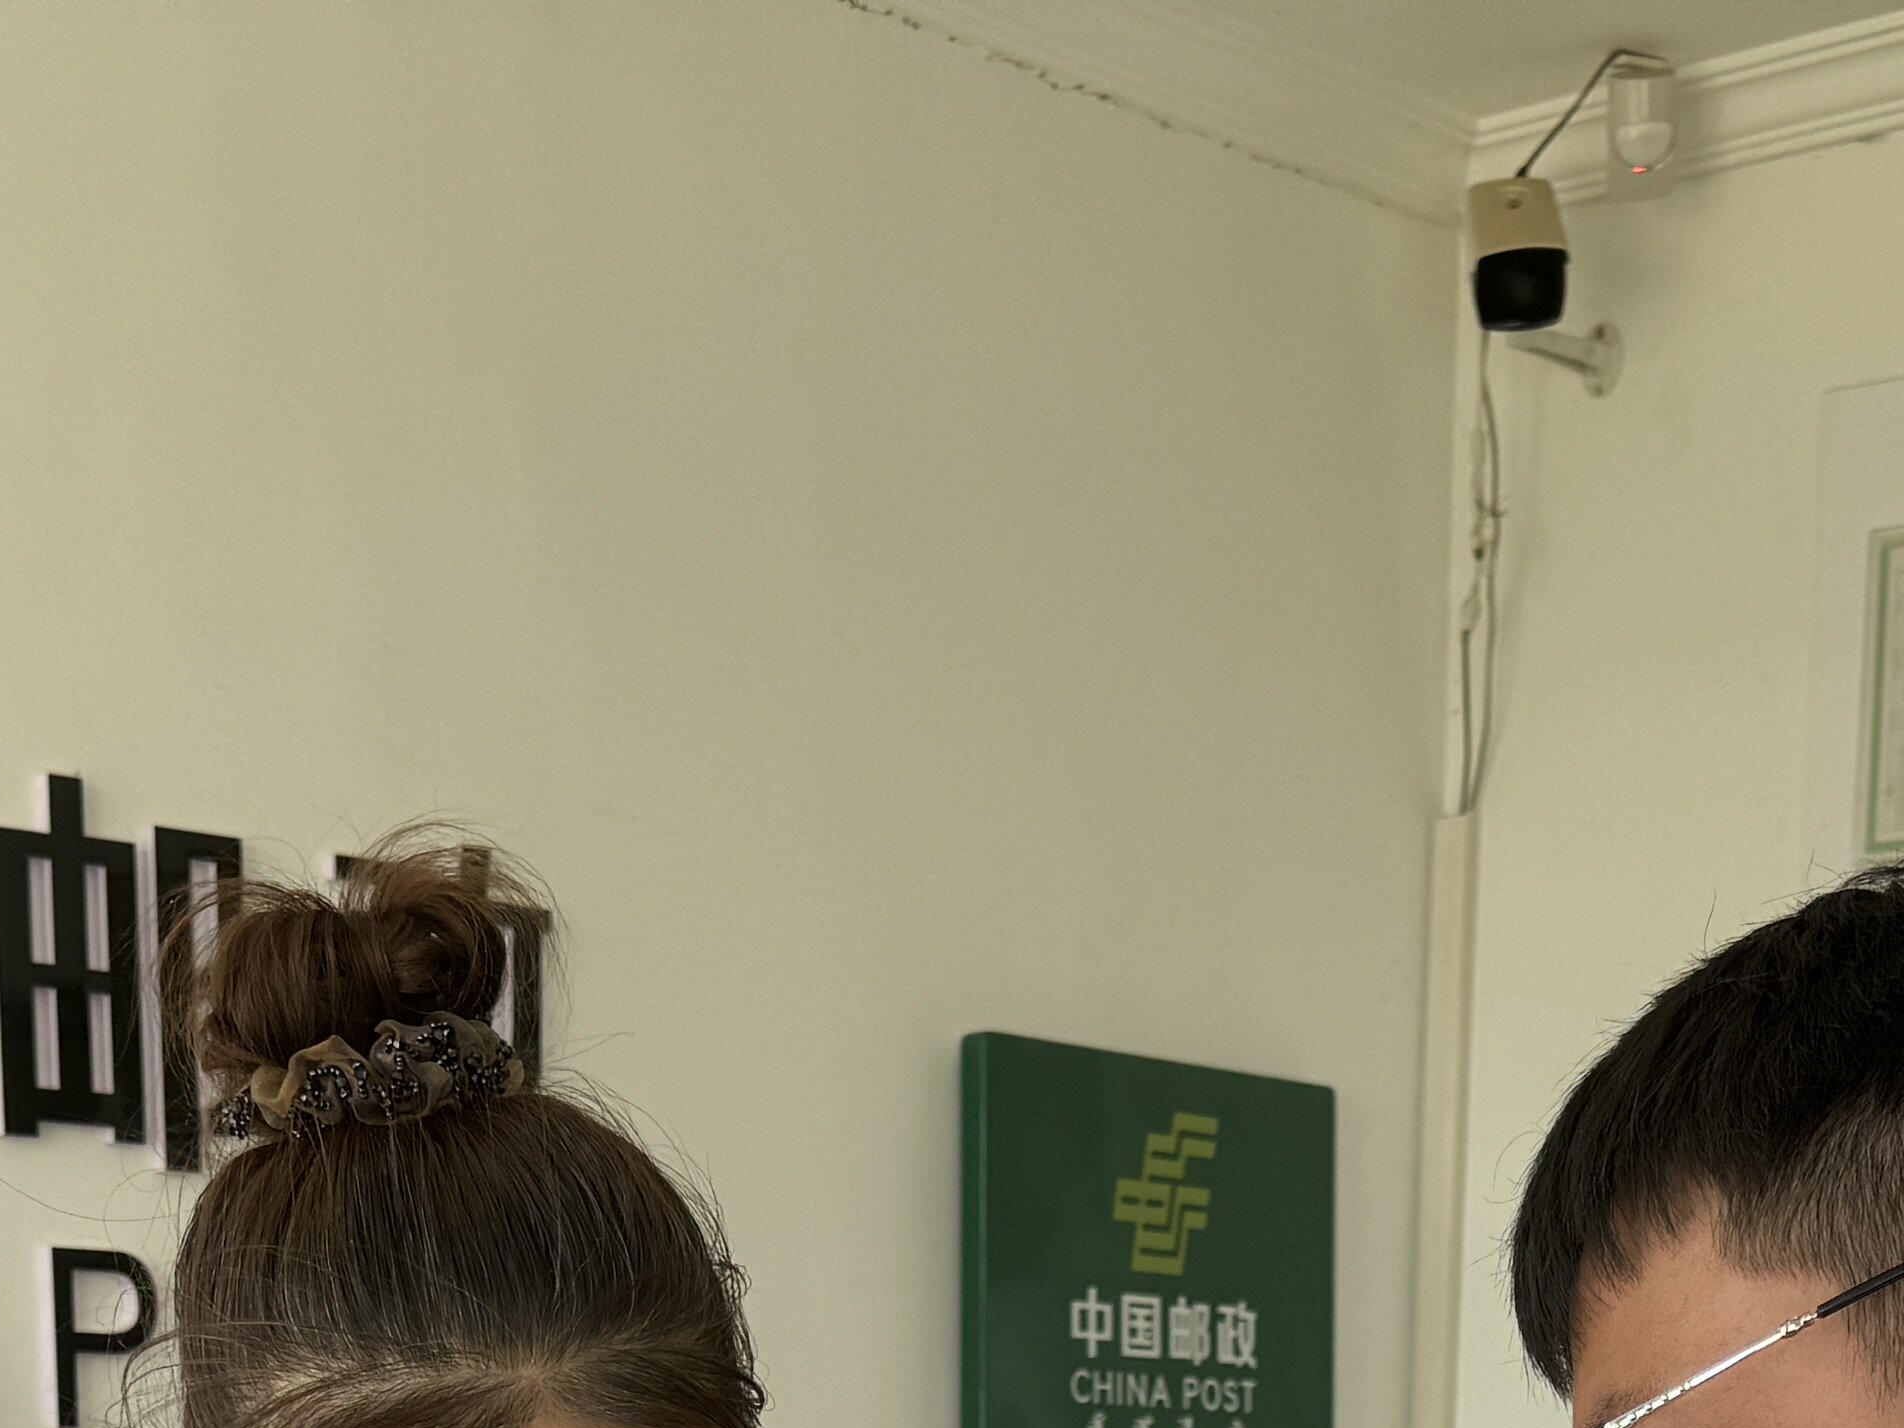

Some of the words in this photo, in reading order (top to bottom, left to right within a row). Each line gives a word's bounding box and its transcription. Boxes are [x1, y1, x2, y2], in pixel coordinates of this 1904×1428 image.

[1070, 1286, 1257, 1370] 中国邮政
[1070, 1367, 1172, 1410] CHINA
[1182, 1376, 1257, 1414] POST
